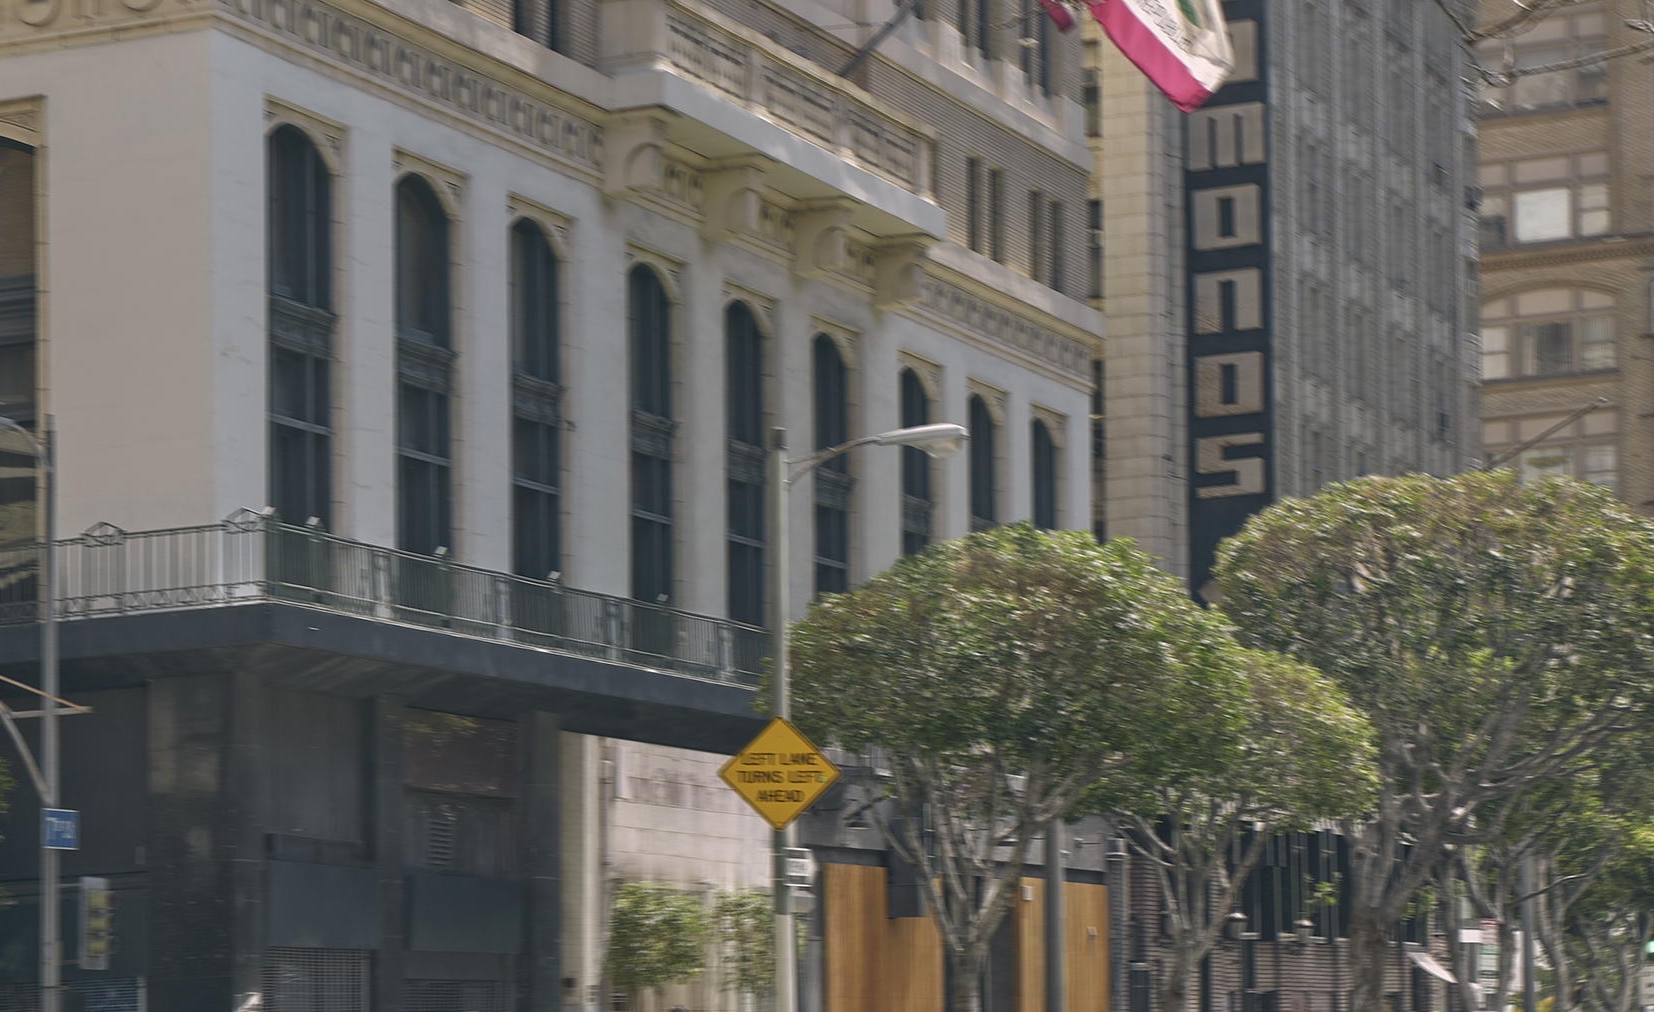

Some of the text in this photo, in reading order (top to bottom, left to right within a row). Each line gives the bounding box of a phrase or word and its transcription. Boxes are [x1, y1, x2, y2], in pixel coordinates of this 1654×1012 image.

[740, 753, 819, 766] LEFT LANE
[736, 771, 825, 783] TURNS LEFT
[755, 789, 806, 803] AHEAD
